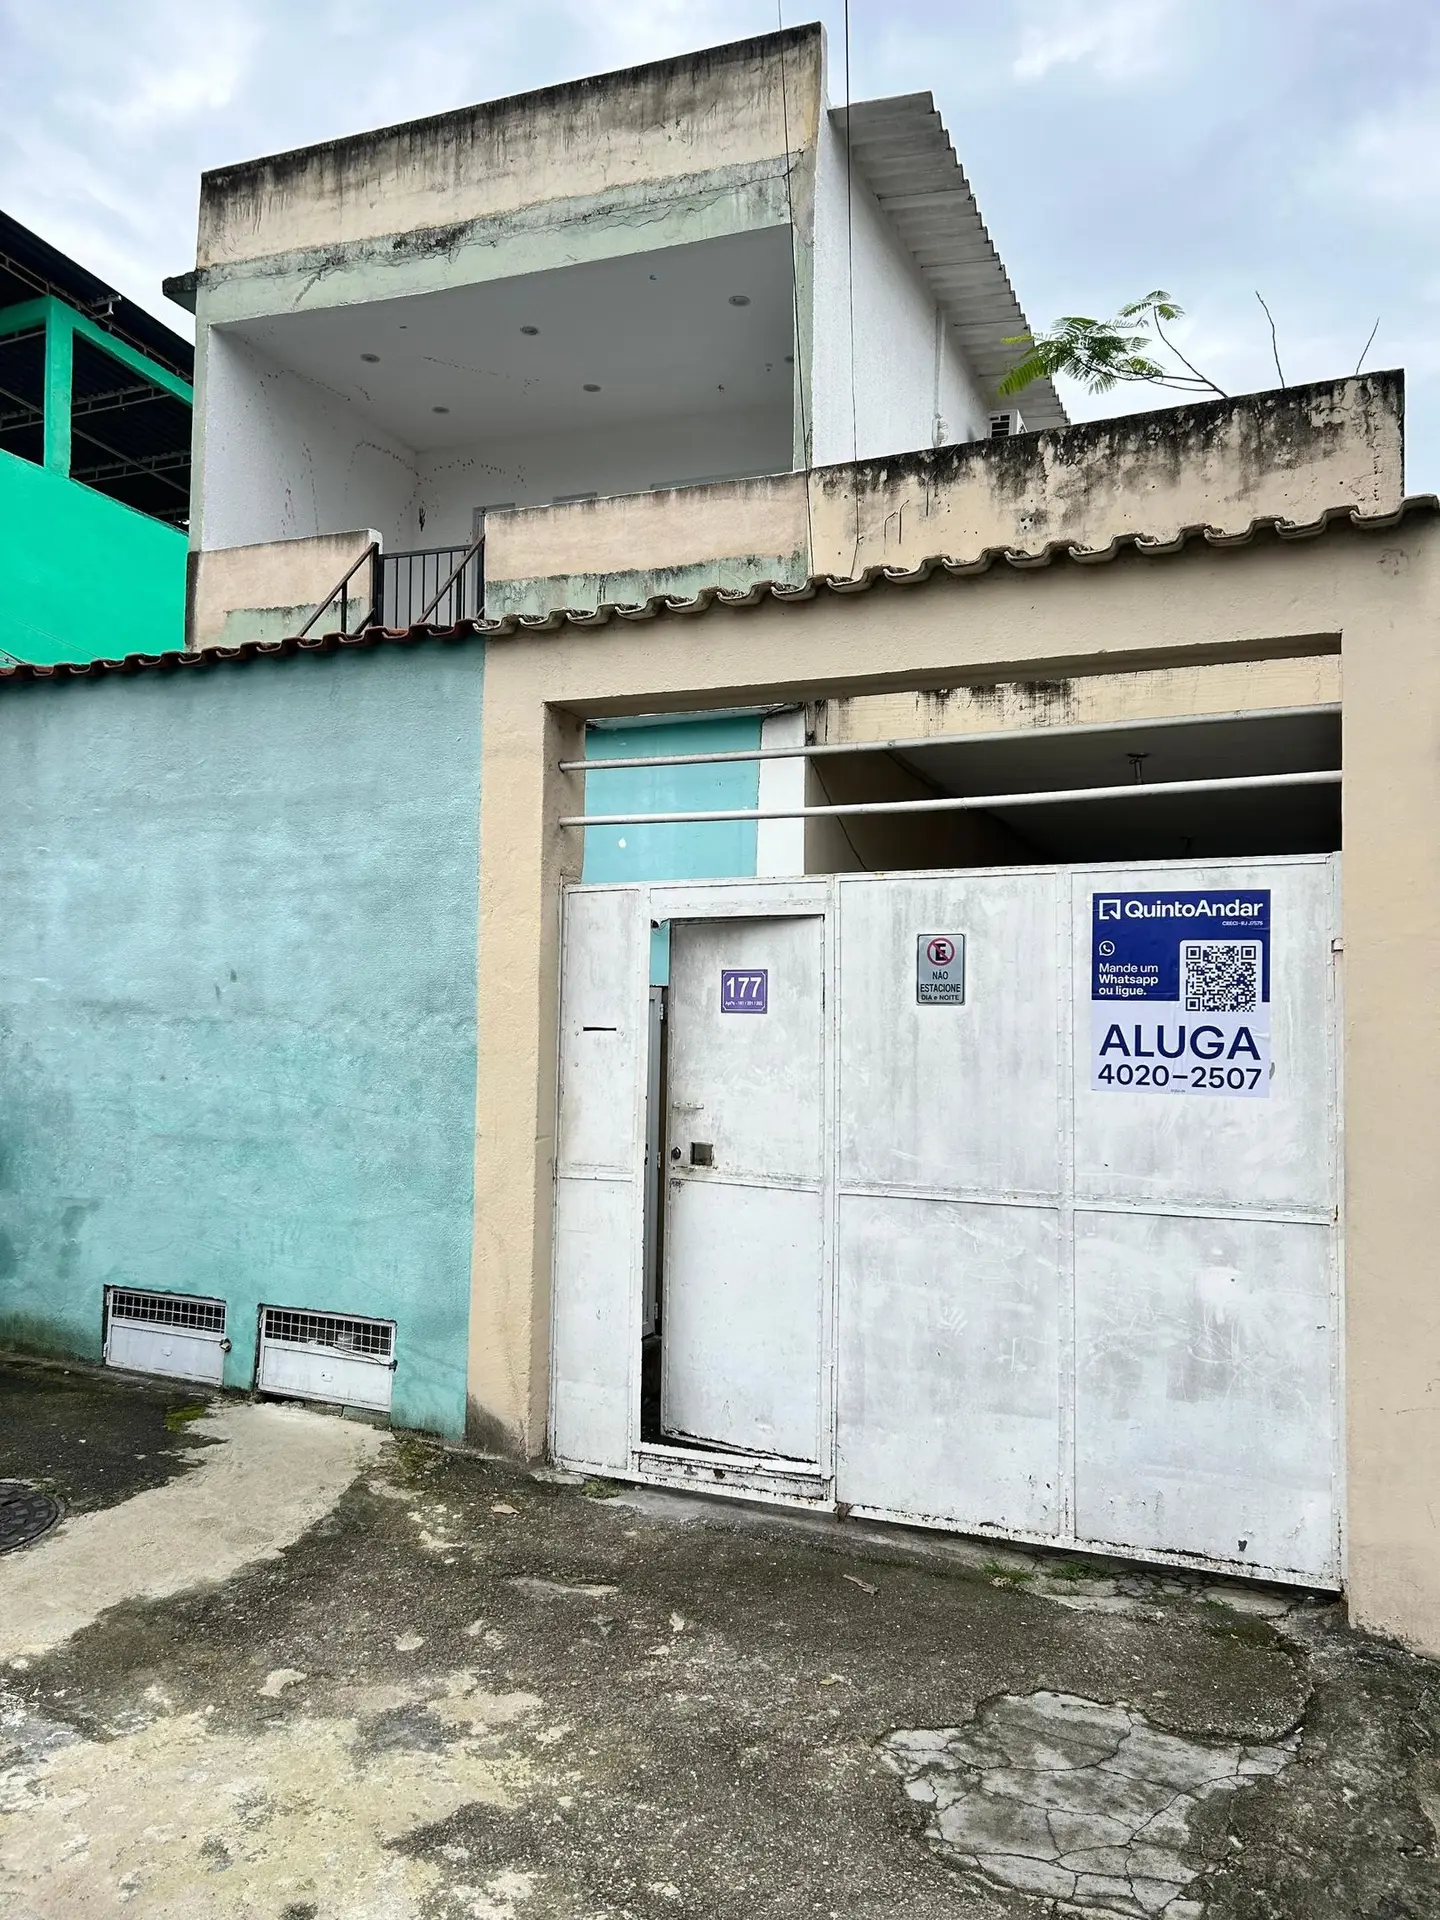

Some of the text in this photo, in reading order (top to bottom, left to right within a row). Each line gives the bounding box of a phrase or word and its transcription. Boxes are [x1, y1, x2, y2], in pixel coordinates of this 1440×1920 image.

[1124, 899, 1263, 919] QuintoAndar
[1099, 963, 1158, 973] Mande um
[932, 969, 949, 980] NÃO
[1098, 974, 1159, 986] Whatsapp
[726, 977, 762, 998] 177
[920, 983, 961, 993] ESTACIONE
[1098, 985, 1147, 997] ou ligue.
[1098, 1023, 1262, 1061] ALUGA
[1097, 1063, 1262, 1090] 4020-2507
